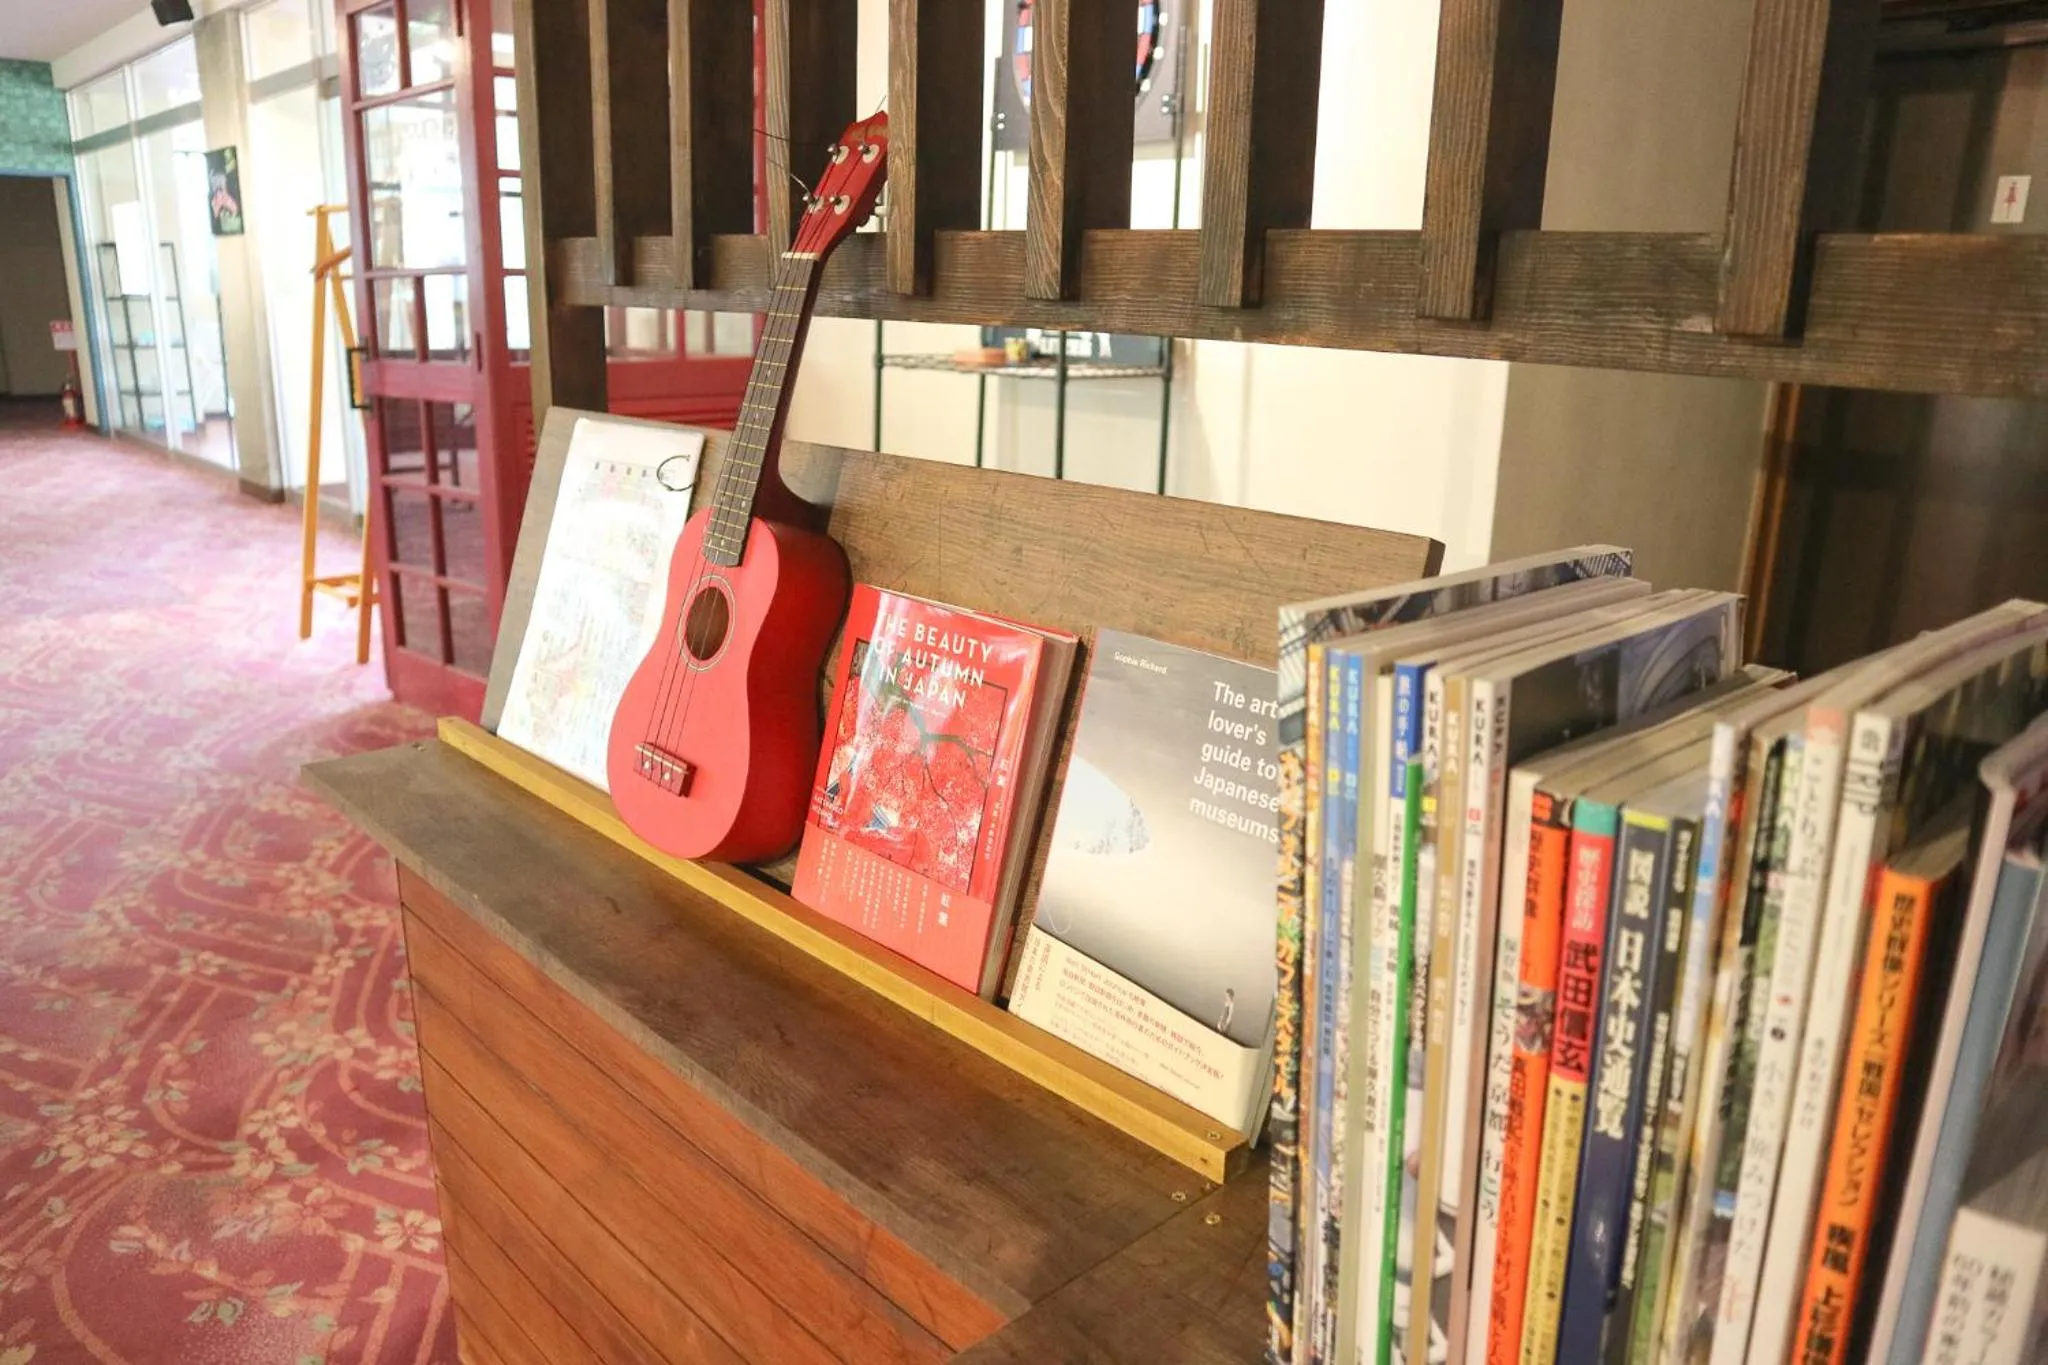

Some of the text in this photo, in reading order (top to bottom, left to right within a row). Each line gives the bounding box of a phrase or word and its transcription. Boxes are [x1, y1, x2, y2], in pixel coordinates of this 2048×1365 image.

[873, 636, 985, 689] OF AUTUMN
[879, 612, 993, 663] HE BEAUTY
[879, 664, 898, 686] IN
[903, 671, 967, 709] JAPAN
[1213, 680, 1279, 720] The art
[1345, 668, 1360, 737] KURA
[1207, 710, 1267, 747] lover's
[1426, 690, 1440, 755] KURA
[1445, 709, 1460, 777] KURA
[1473, 699, 1486, 766] KURA
[1200, 742, 1277, 782] guide to
[1193, 766, 1281, 813] Japanese
[1188, 796, 1281, 844] museums
[1555, 940, 1600, 1075] 武田信玄
